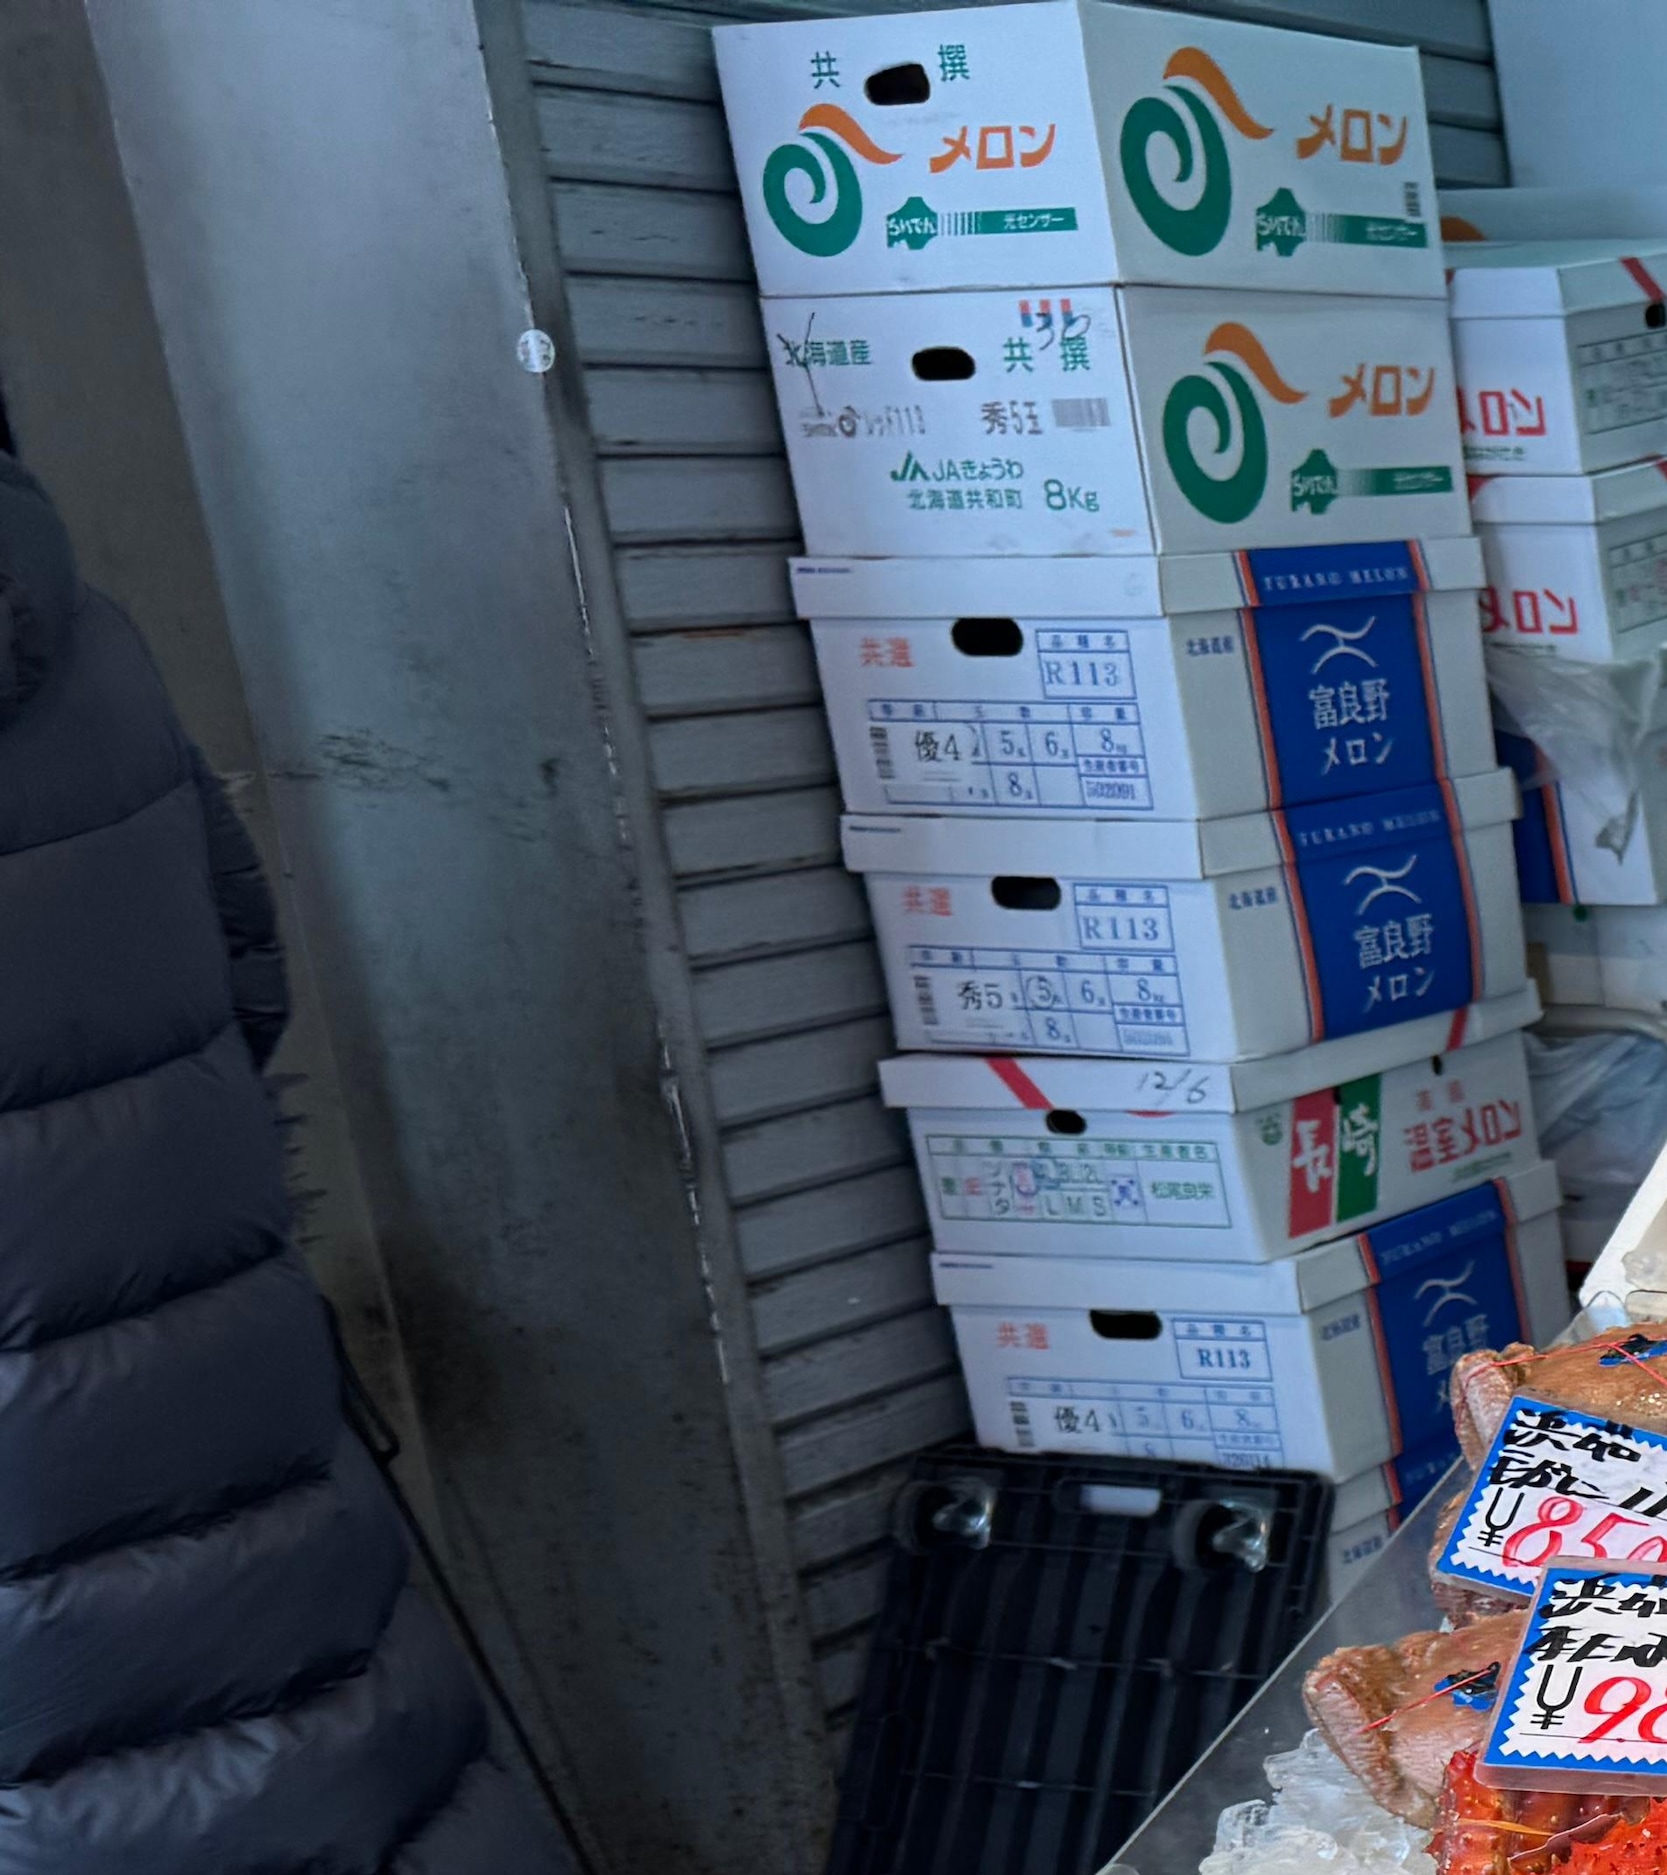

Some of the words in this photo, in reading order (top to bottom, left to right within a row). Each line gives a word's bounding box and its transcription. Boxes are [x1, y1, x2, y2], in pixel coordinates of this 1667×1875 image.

[929, 122, 1056, 174] メロン
[1296, 102, 1408, 166] メロン
[1328, 363, 1435, 419] メロン
[1045, 660, 1120, 687] R113
[1308, 678, 1392, 730] 富良野
[1321, 731, 1395, 776] メロン
[1082, 916, 1159, 942] R113
[1354, 913, 1436, 970] 富良野
[1362, 966, 1436, 1014] メロン
[1197, 1347, 1252, 1370] R113
